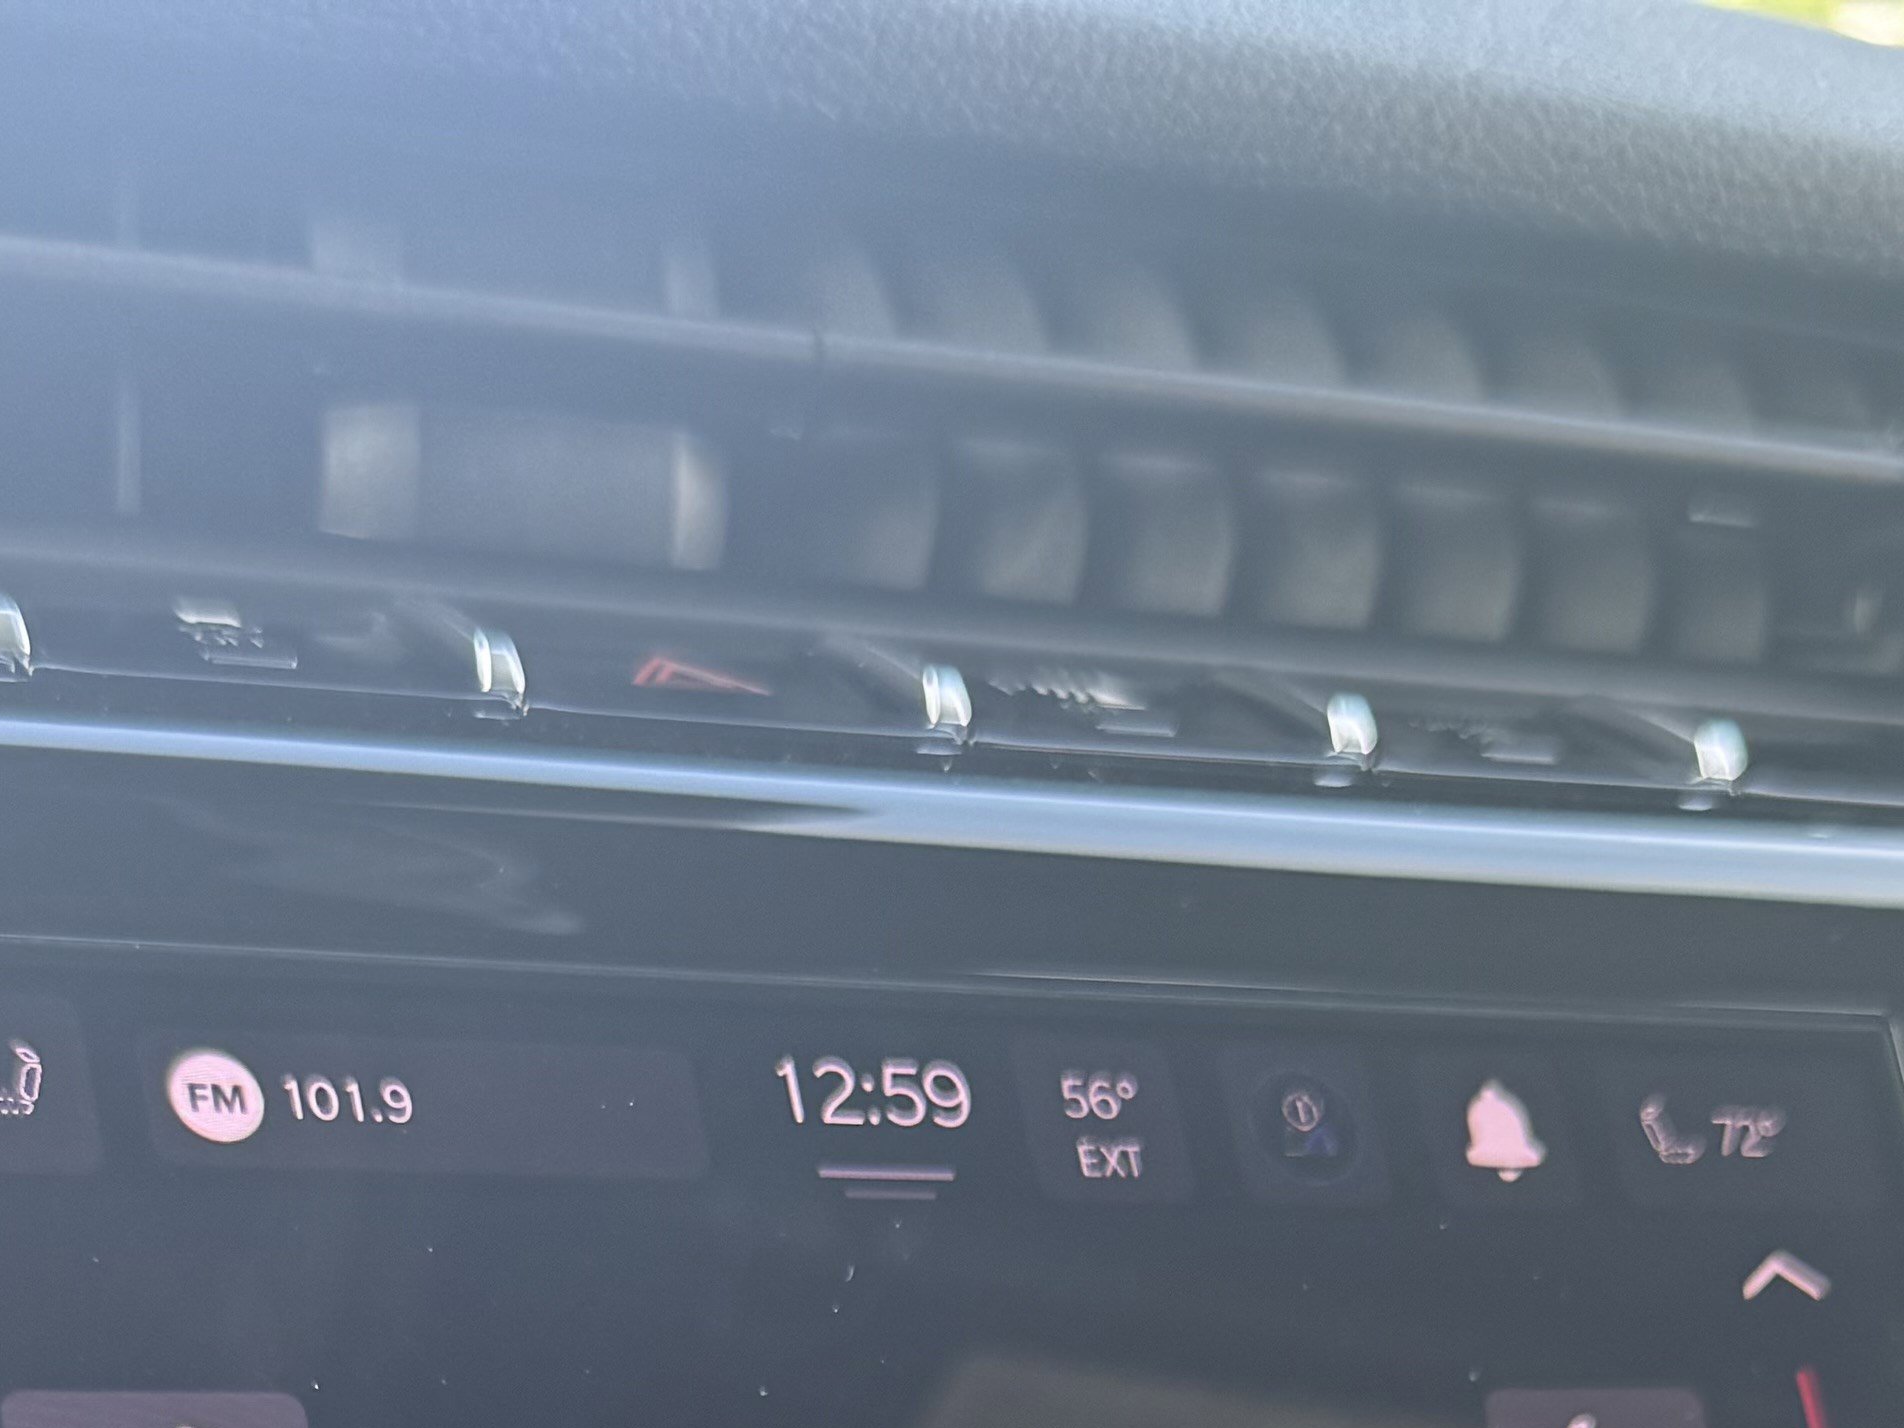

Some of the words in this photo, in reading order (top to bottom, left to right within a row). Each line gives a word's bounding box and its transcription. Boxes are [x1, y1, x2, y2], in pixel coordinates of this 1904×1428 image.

[187, 1081, 248, 1115] FM
[282, 1074, 414, 1124] 101.9
[775, 1054, 972, 1129] 12:59
[1060, 1070, 1138, 1119] 56°
[1077, 1135, 1142, 1178] EXT
